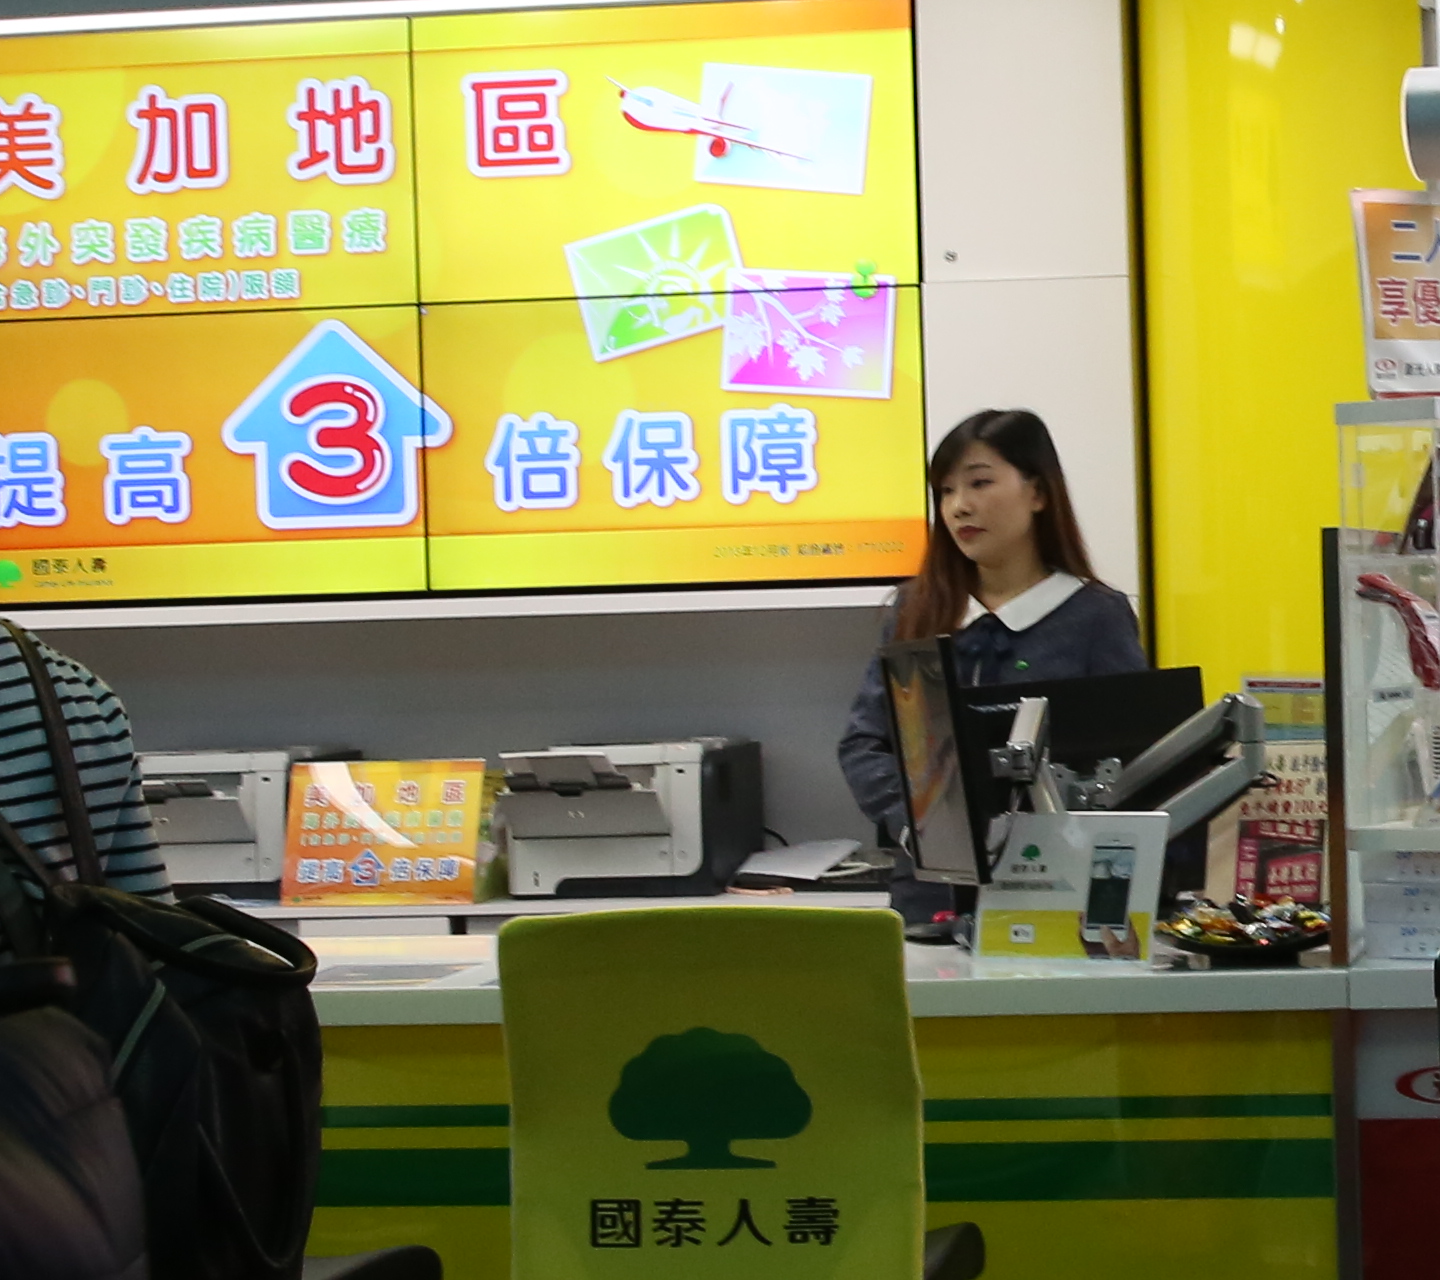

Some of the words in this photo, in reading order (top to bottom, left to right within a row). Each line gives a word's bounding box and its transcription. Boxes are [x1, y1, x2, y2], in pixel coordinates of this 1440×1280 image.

[281, 373, 389, 508] 3
[485, 402, 820, 512] 倍保障
[589, 1196, 840, 1249] 國泰人壽
